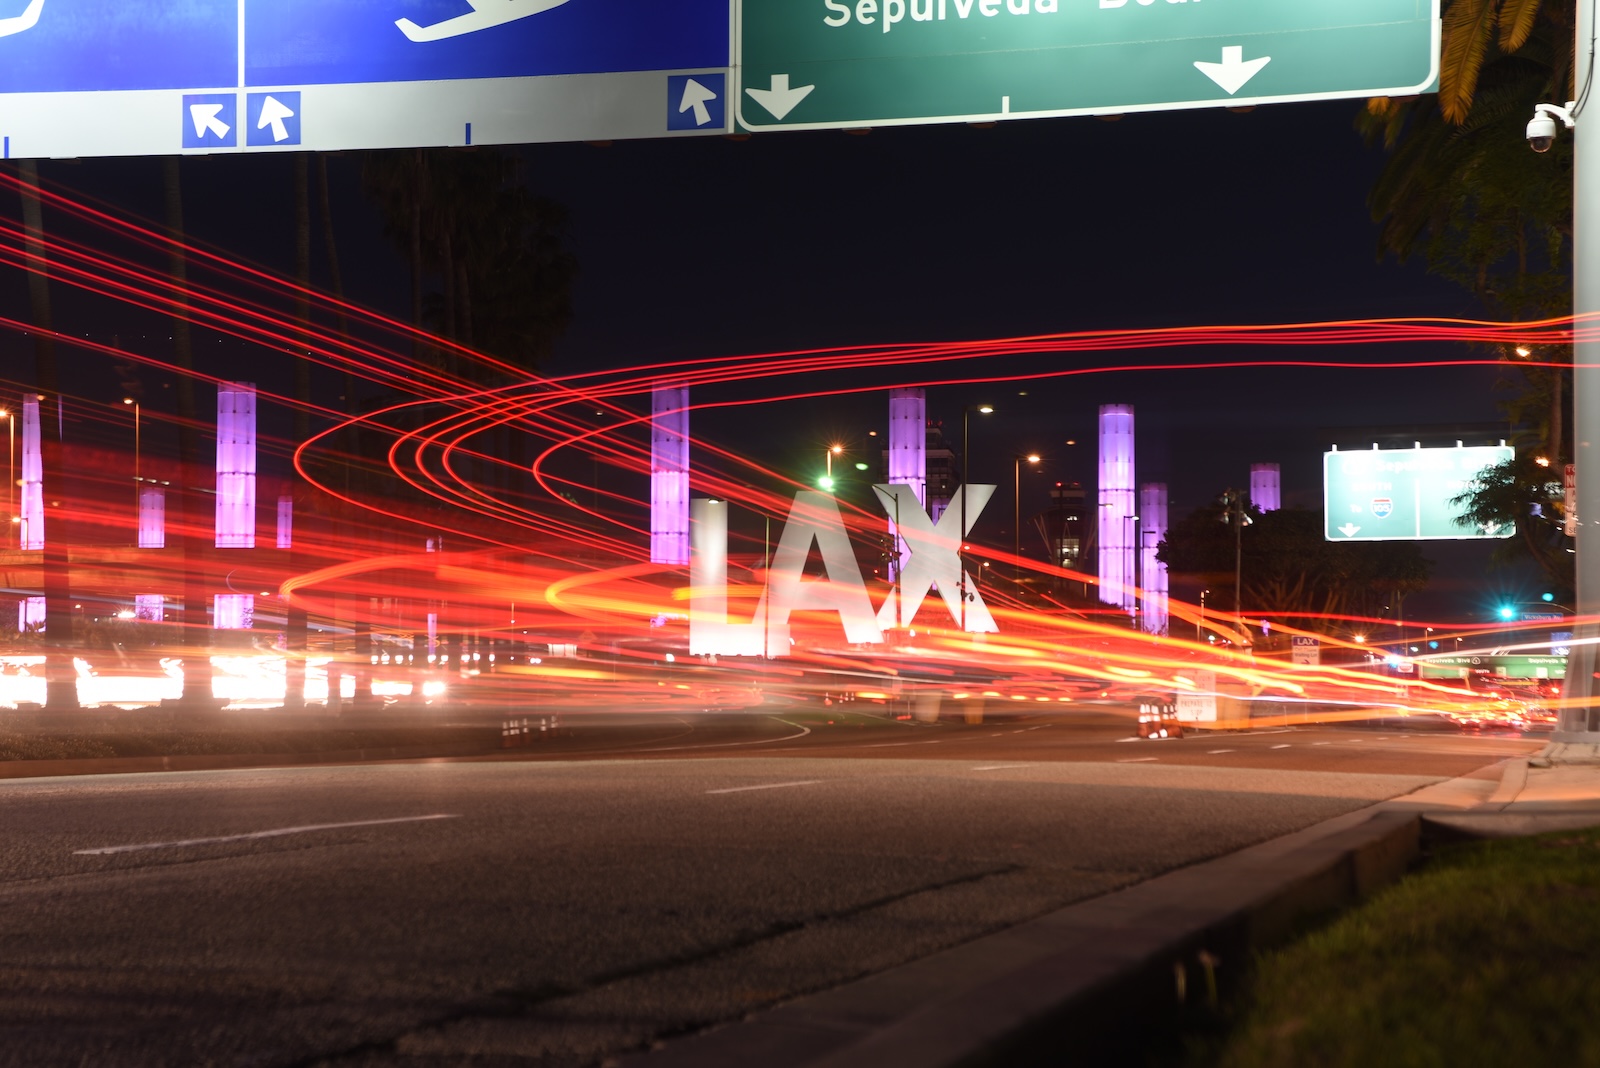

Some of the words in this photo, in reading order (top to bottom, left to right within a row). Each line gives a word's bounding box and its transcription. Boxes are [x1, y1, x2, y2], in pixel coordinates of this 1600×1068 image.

[1373, 504, 1391, 513] 105
[690, 484, 1000, 656] LAX
[1297, 638, 1315, 646] LAX
